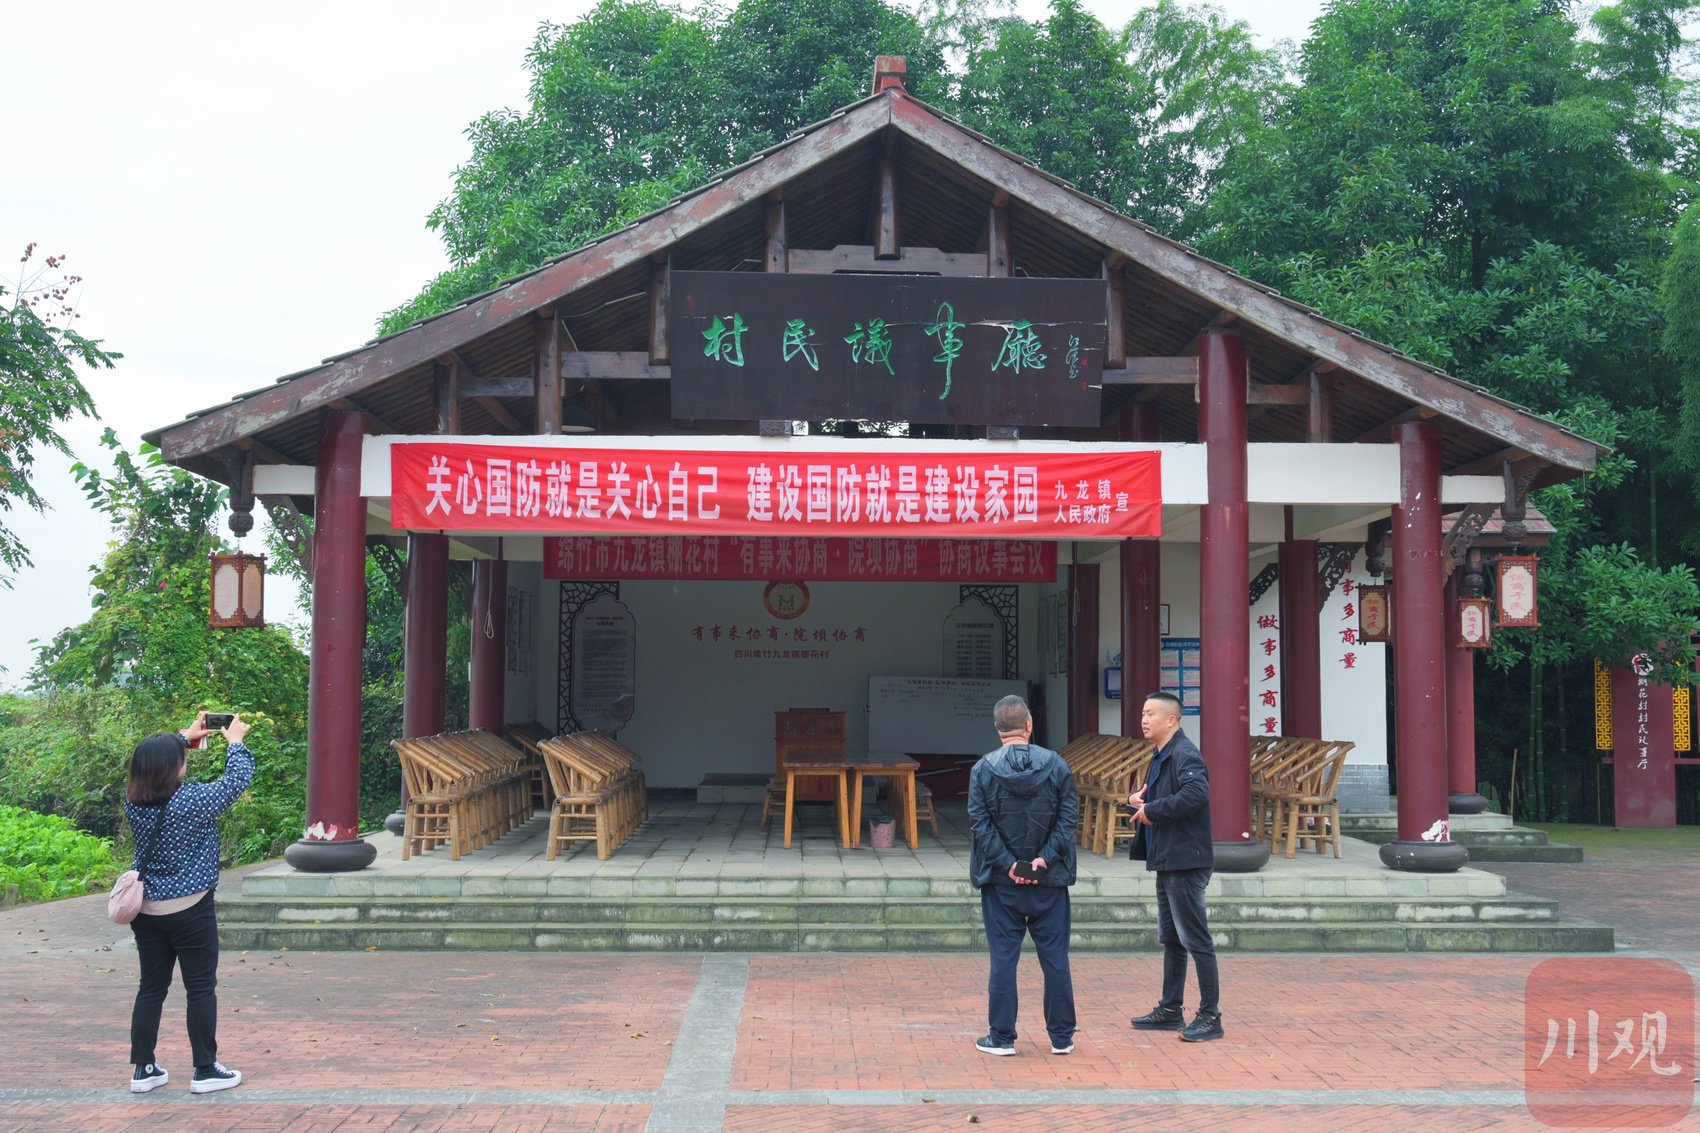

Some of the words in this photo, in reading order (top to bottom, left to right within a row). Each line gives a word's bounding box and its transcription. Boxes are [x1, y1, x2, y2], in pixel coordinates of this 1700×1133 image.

[701, 301, 1048, 400] 村民議事廳
[425, 454, 721, 522] 关心国防就是关心自己
[746, 463, 1039, 524] 建设国防就是建设家园
[1054, 478, 1112, 501] 九龙镇
[1115, 491, 1129, 512] 宣
[1054, 502, 1111, 525] 人民政府
[938, 540, 1044, 576] 协商议事会议
[1257, 614, 1280, 734] 做事多商量
